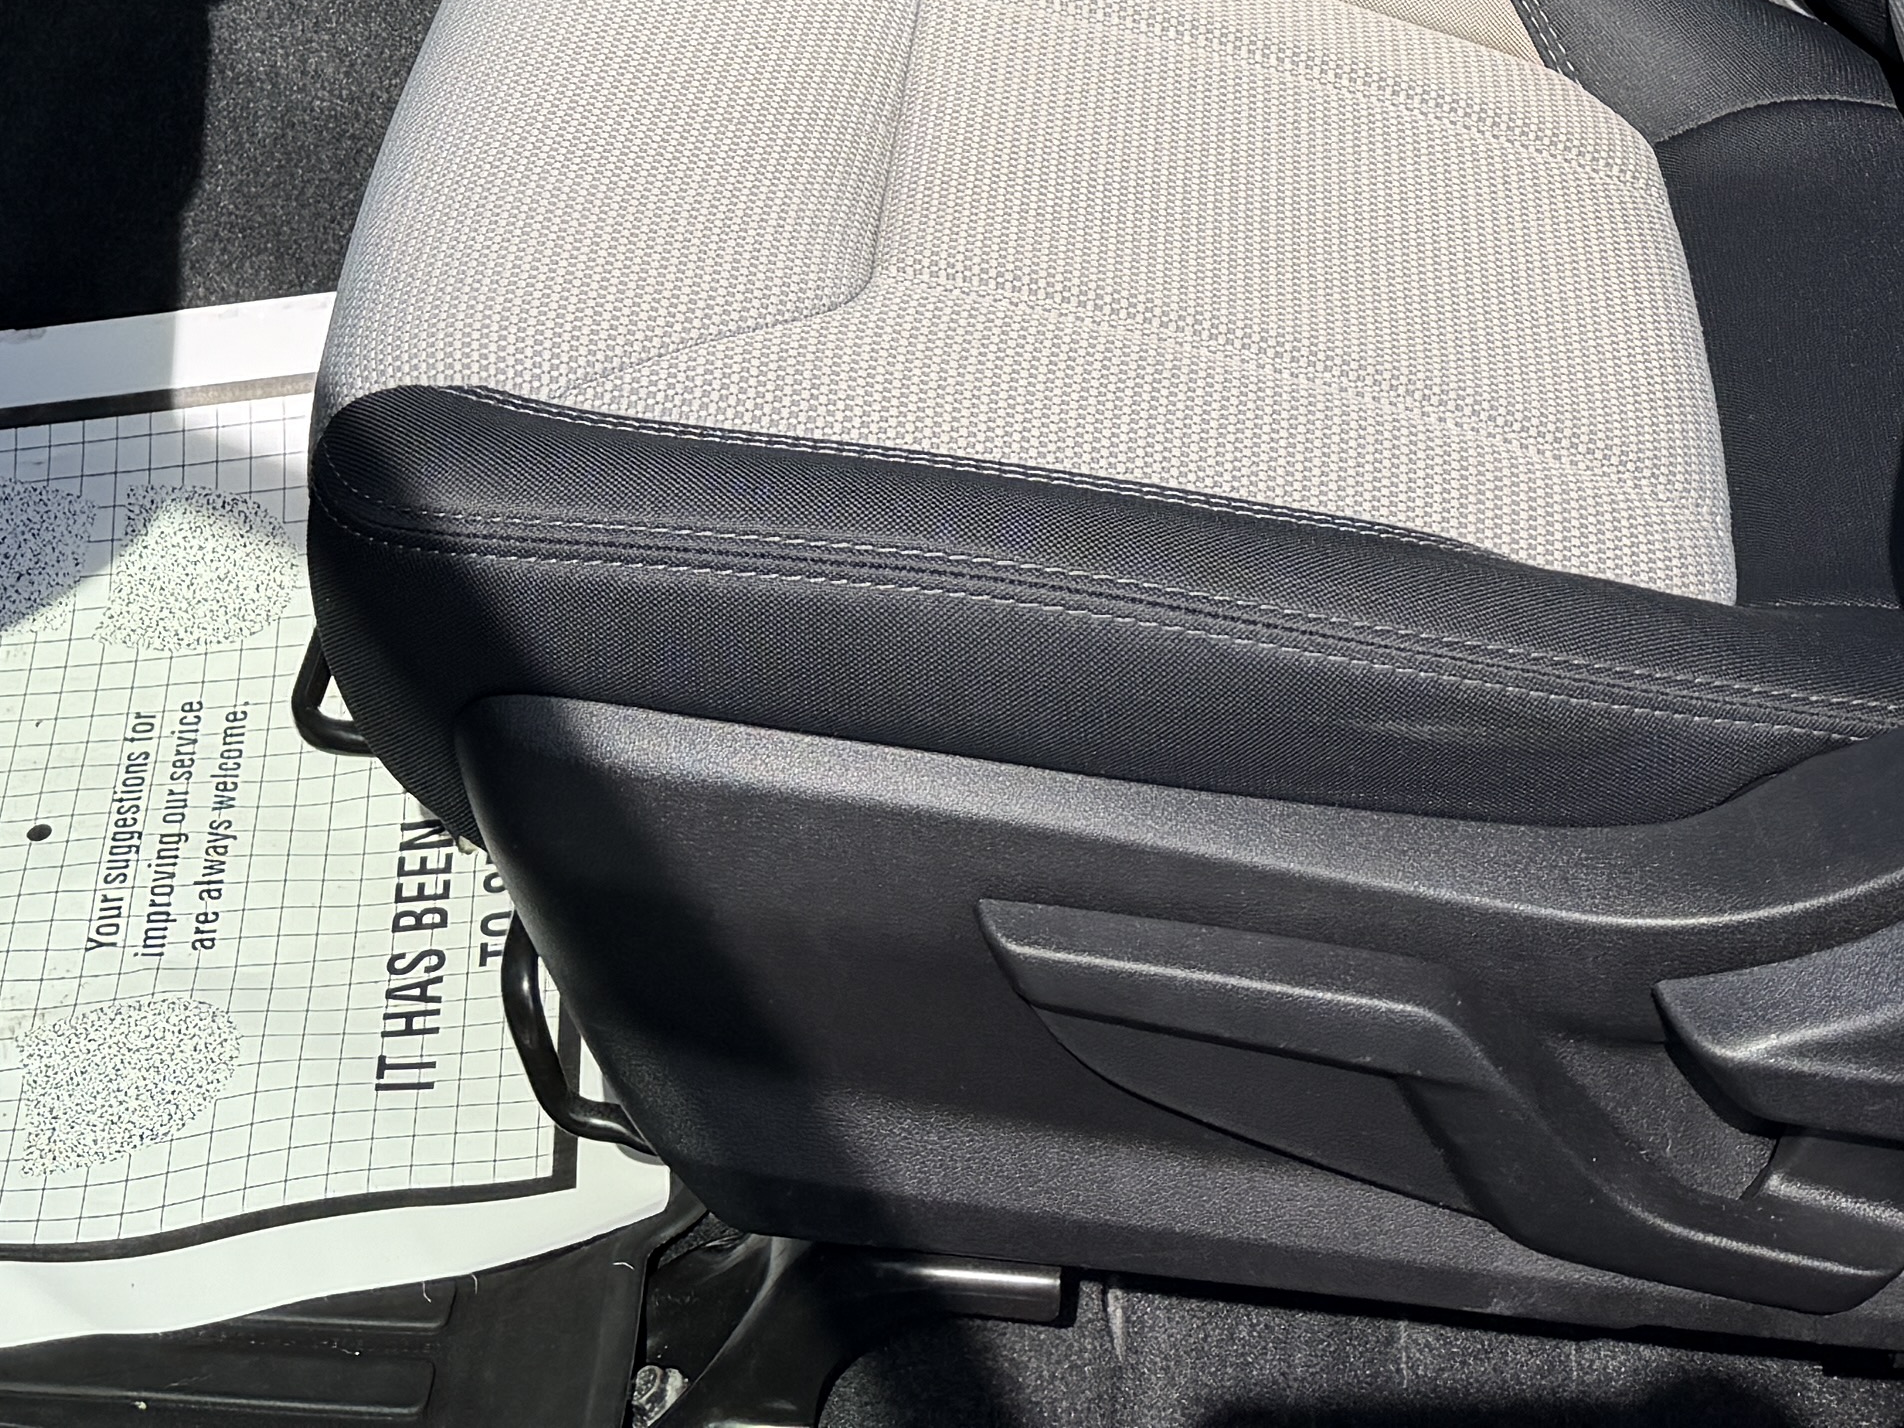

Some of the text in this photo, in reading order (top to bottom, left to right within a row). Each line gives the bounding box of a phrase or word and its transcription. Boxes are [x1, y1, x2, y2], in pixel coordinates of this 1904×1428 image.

[84, 711, 157, 953] Your suggestions for
[132, 699, 204, 958] improving our service
[190, 700, 250, 952] are always welcome.
[375, 818, 455, 1092] IT HAS BEEN
